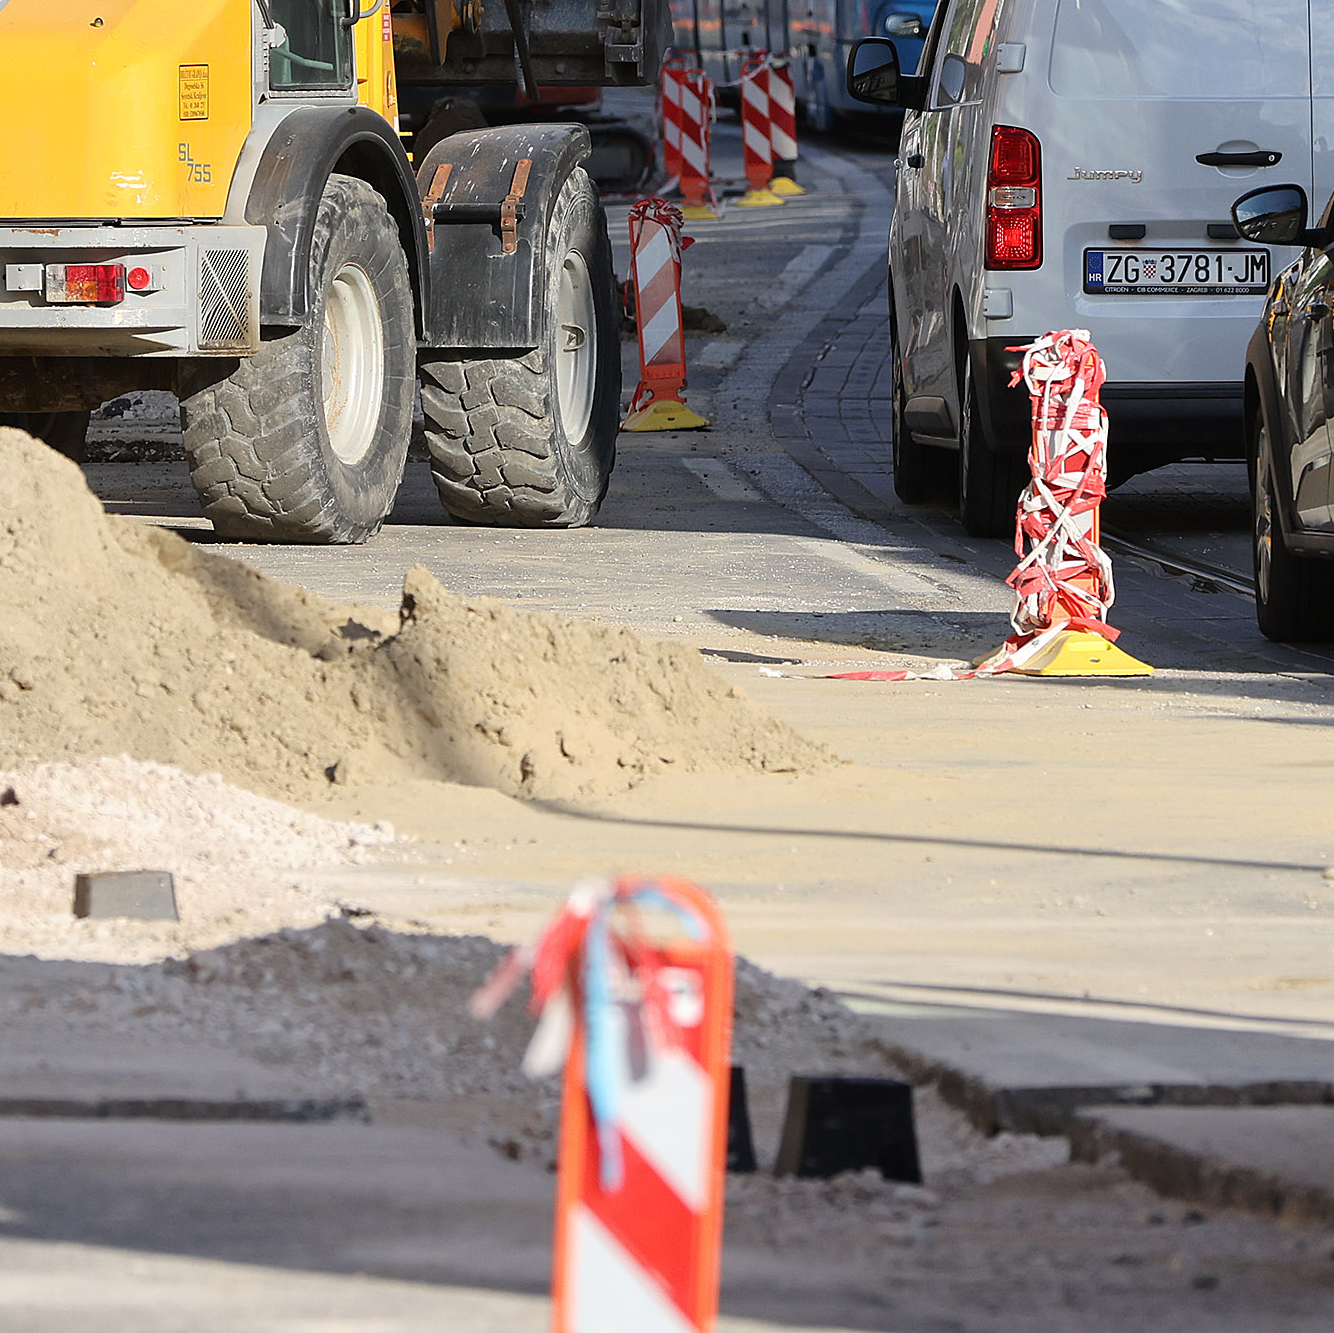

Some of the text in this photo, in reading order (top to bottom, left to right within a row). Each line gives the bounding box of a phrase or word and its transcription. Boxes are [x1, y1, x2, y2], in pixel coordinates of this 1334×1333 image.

[178, 143, 194, 162] SL
[187, 163, 211, 183] 755
[1067, 166, 1143, 184] Jumpy
[1088, 273, 1102, 282] HR
[1106, 254, 1140, 283] ZG
